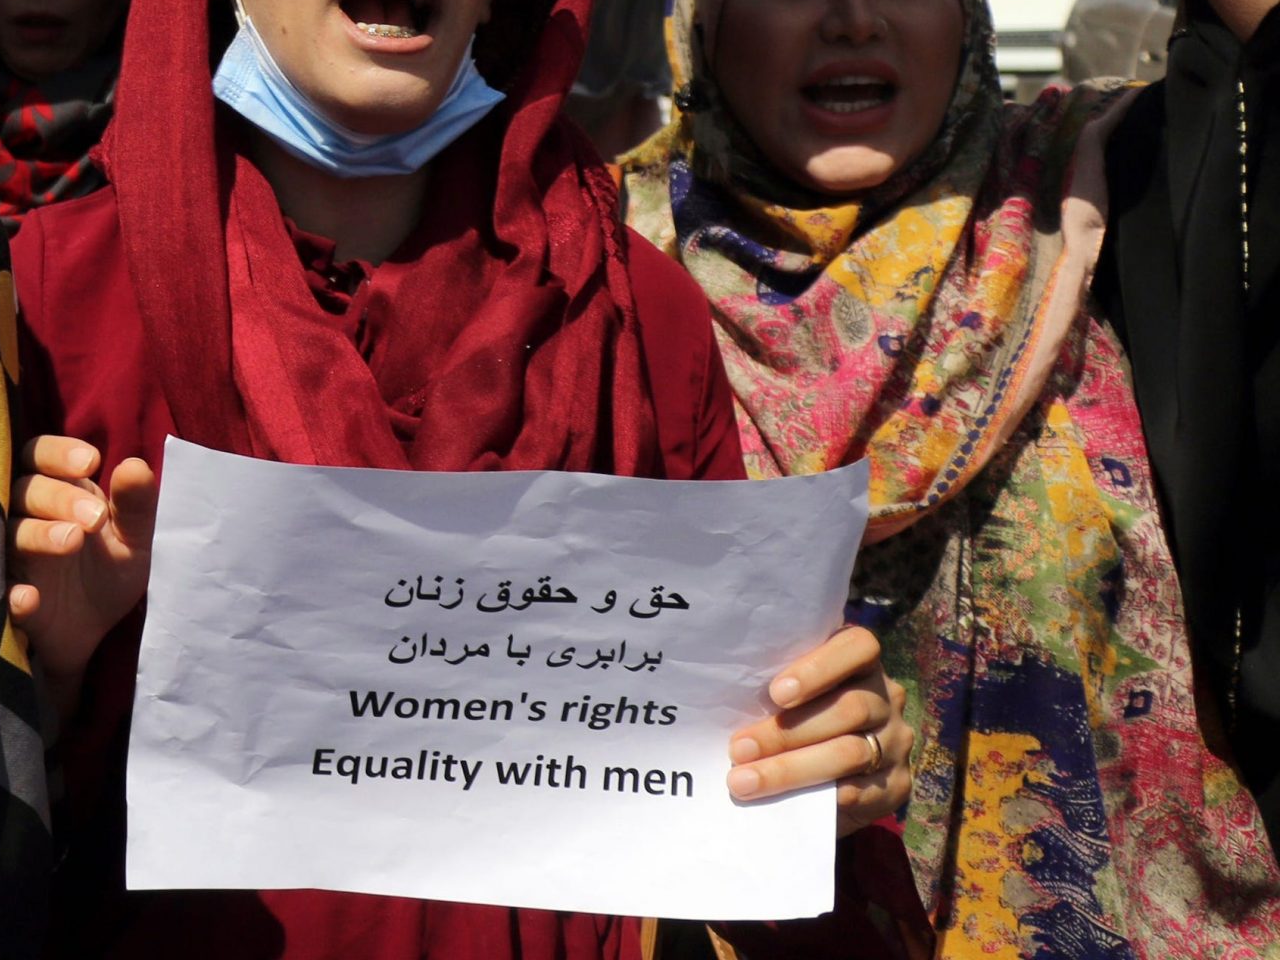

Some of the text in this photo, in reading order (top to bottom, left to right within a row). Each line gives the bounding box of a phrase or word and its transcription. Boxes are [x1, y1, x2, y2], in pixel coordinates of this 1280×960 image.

[384, 574, 691, 620] حق و حقوق زنان
[387, 632, 664, 673] برابری با مردان
[348, 689, 679, 731] Women's rights
[311, 748, 694, 798] Equality with men
